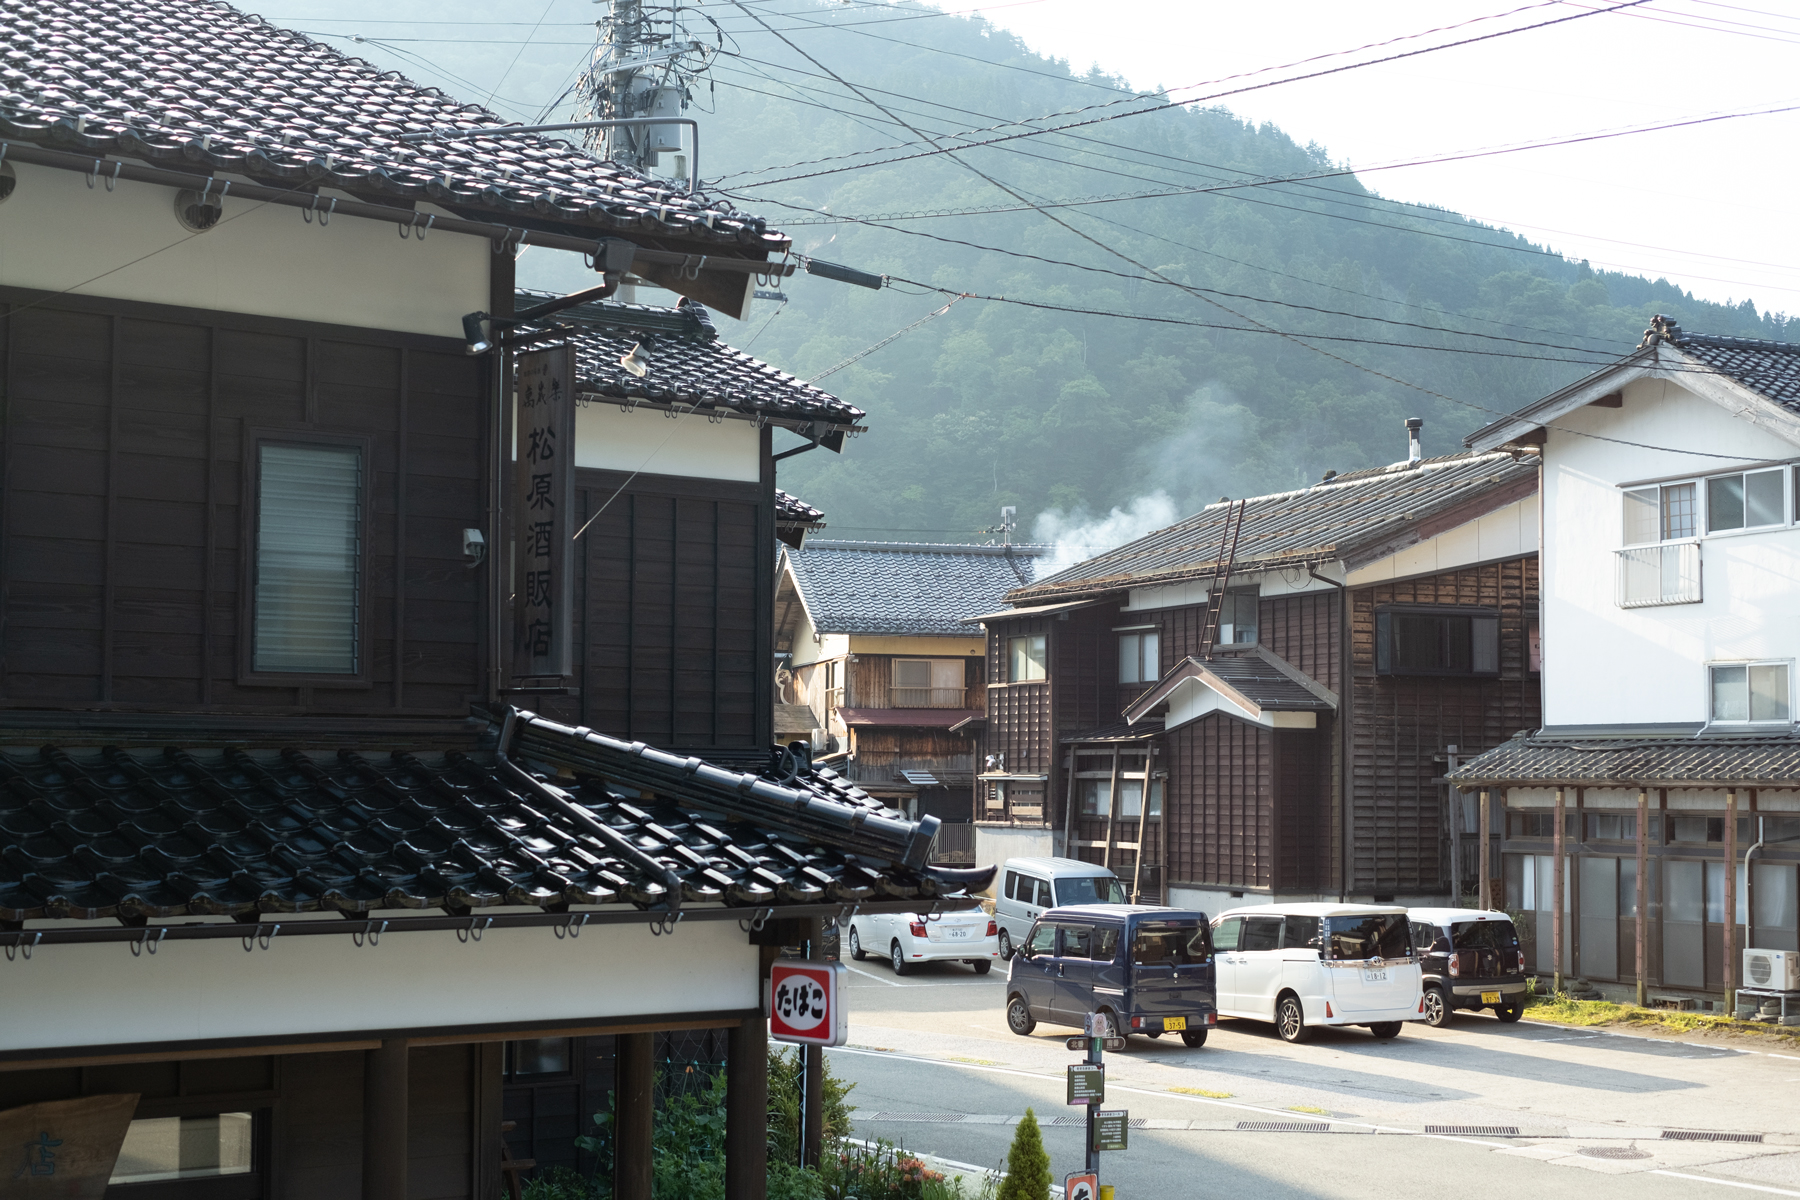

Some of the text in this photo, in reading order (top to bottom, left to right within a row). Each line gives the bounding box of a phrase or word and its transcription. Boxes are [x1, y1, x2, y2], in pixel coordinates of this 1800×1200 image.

[525, 425, 556, 659] 松原酒販店
[777, 982, 823, 1020] たばこ
[13, 1131, 63, 1178] 店
